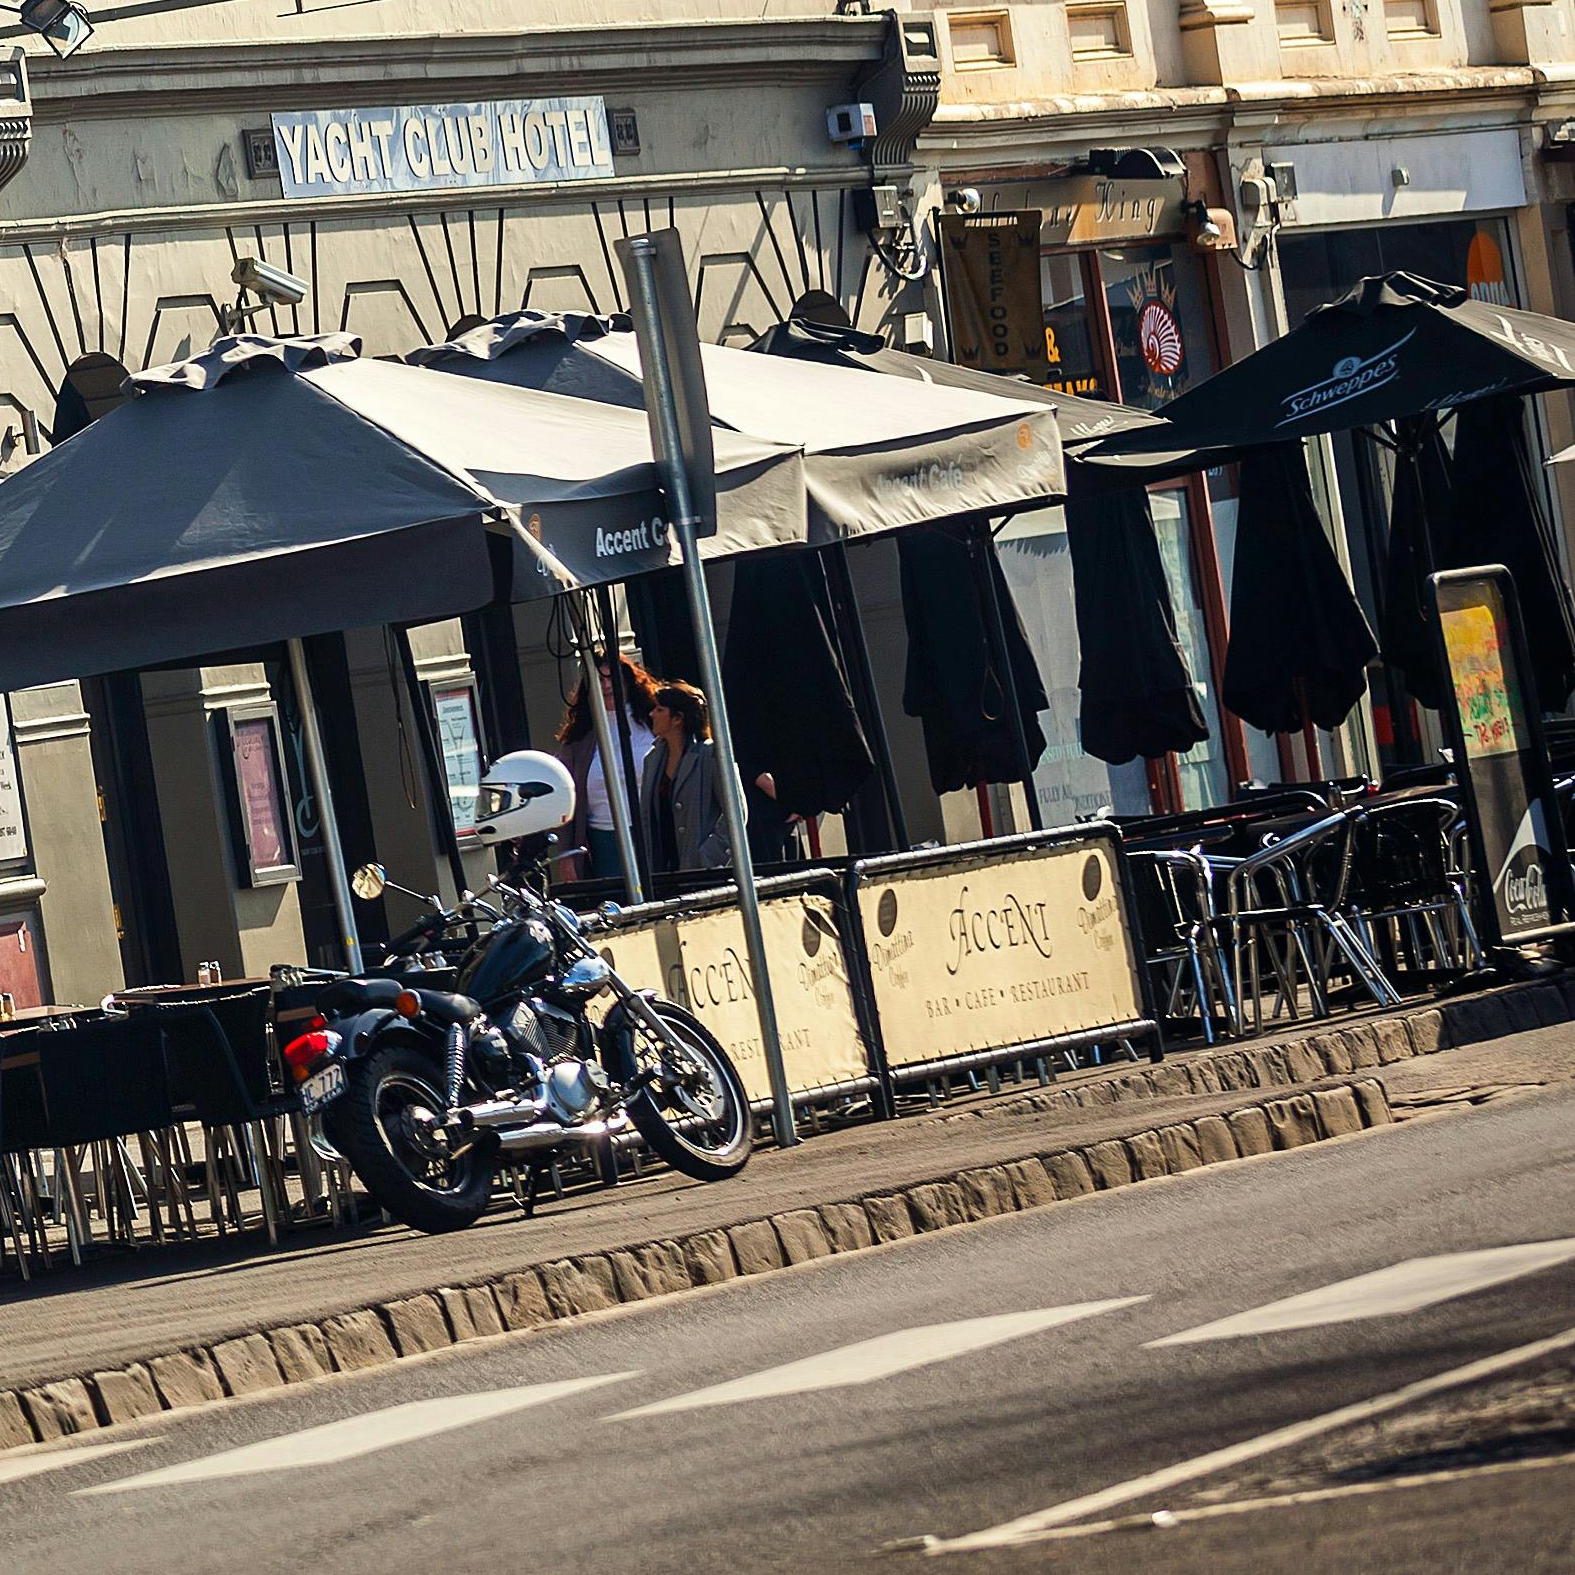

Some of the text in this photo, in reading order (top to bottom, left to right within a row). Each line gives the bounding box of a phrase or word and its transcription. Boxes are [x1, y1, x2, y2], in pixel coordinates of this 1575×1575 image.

[277, 109, 610, 185] YACHT CLUB HOTEL
[1095, 182, 1157, 231] King
[1045, 327, 1061, 363] &
[1285, 354, 1398, 418] Schweppes
[596, 520, 650, 557] Accent
[946, 886, 1052, 976] ACCENT
[925, 972, 1090, 1018] BAR CAFE RESTAURANT
